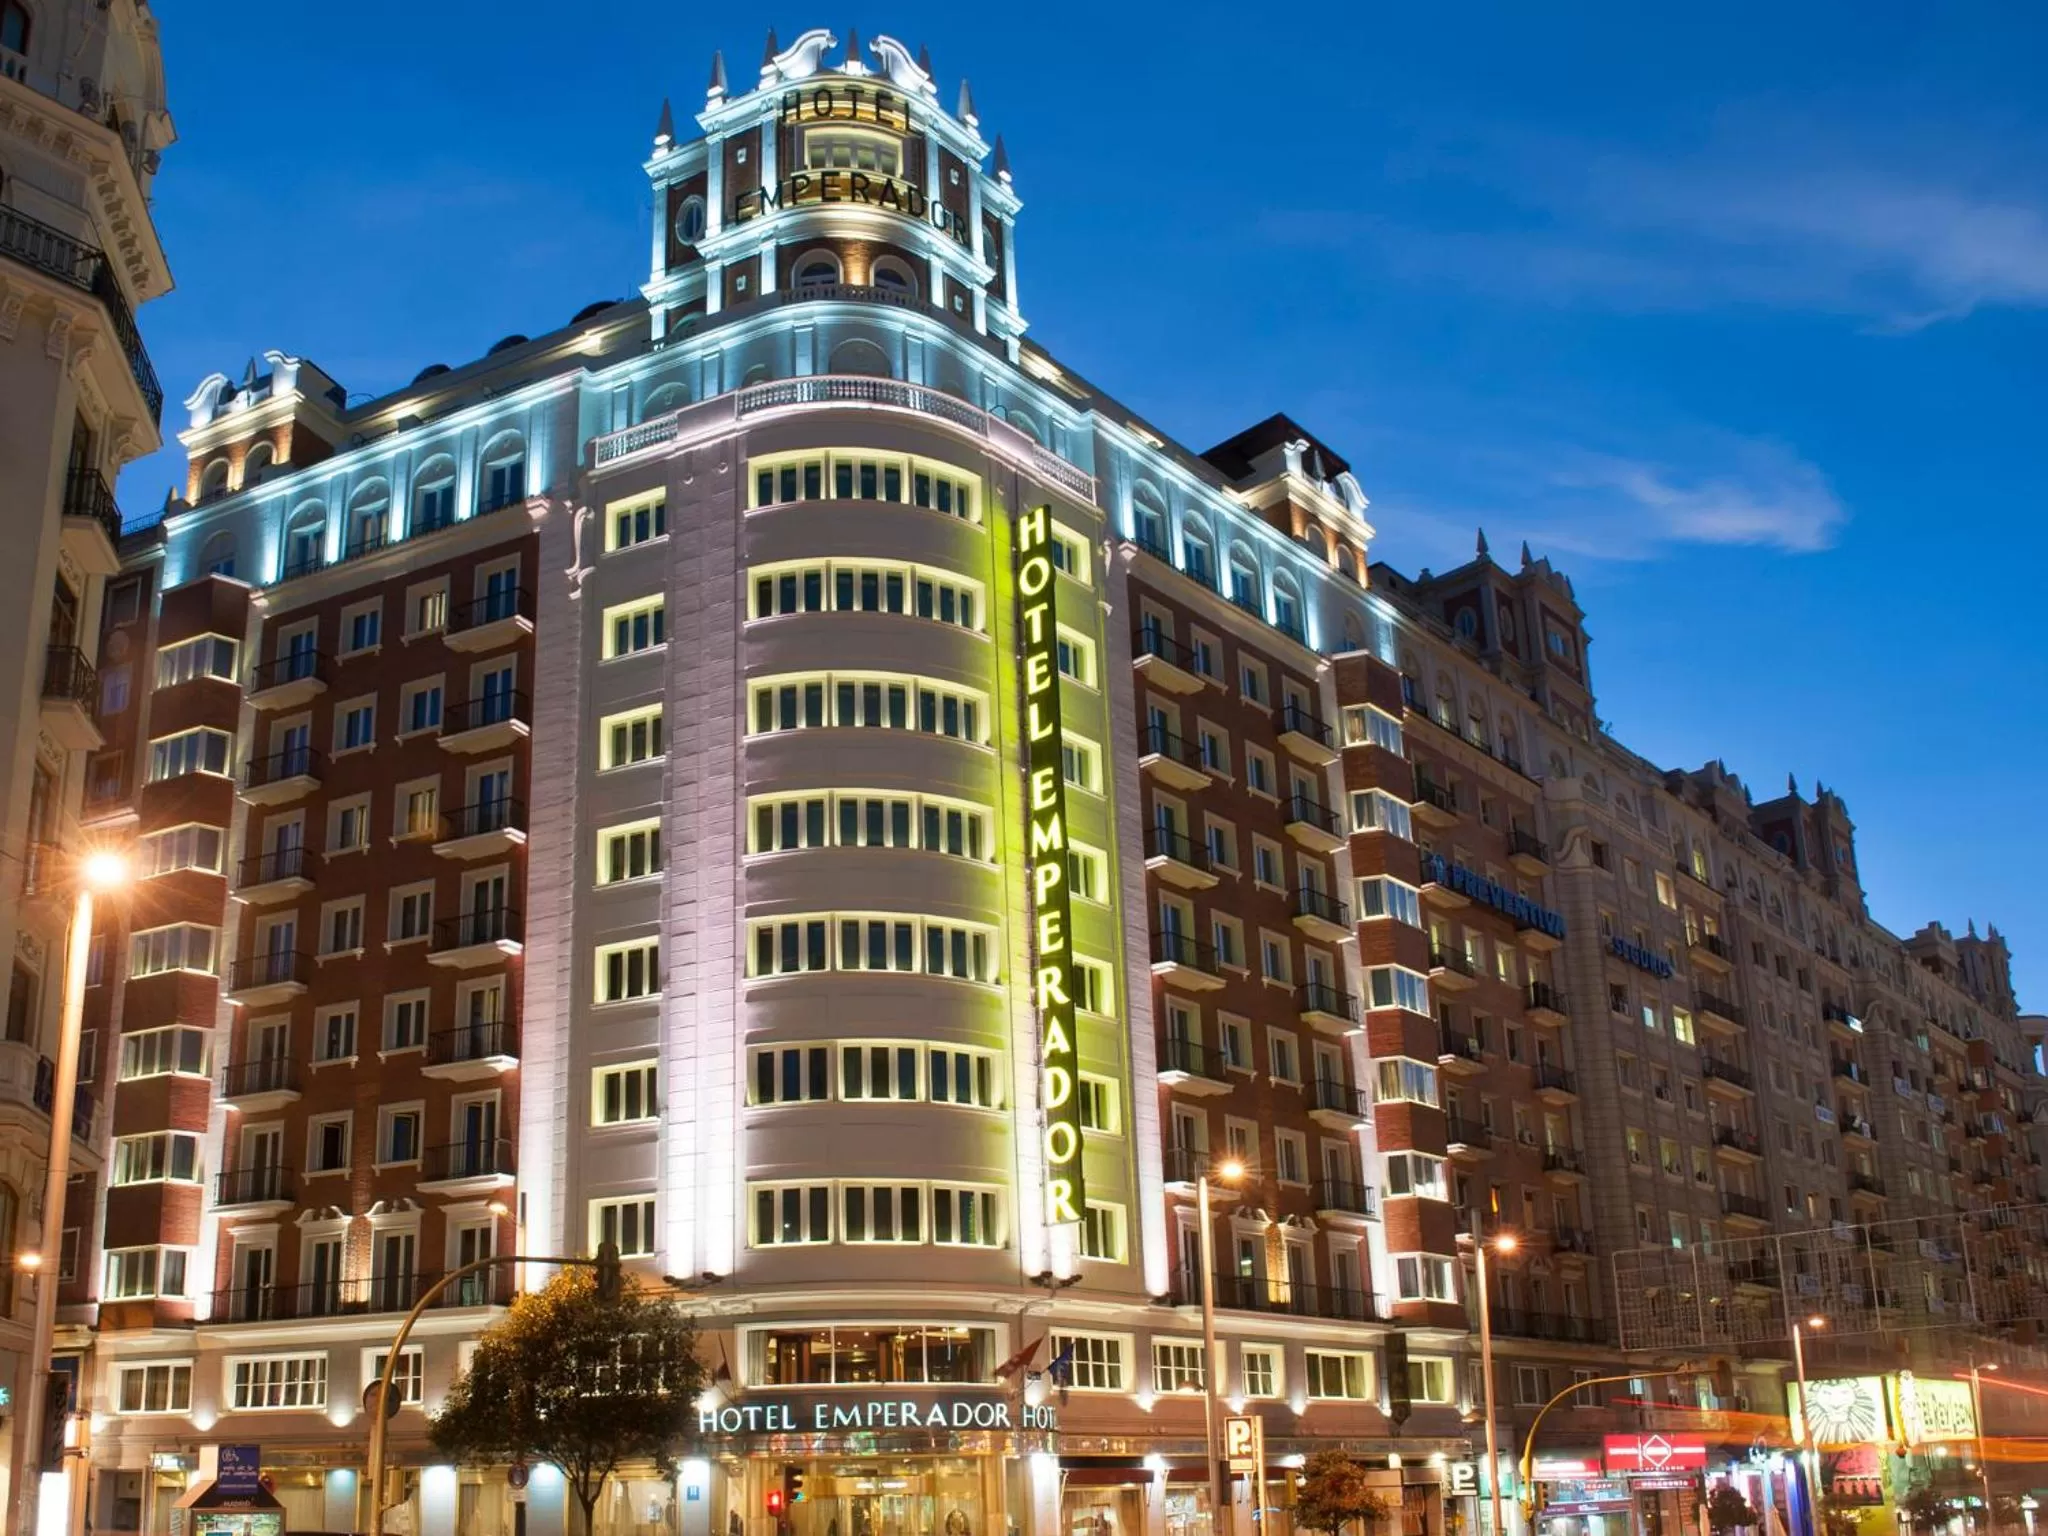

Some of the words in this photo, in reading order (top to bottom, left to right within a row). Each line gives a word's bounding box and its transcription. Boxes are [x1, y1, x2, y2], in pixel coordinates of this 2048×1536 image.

[781, 86, 915, 134] HOTEL
[735, 170, 968, 247] EMPERADOR
[1019, 507, 1053, 742] HOTEL
[1032, 767, 1080, 1222] EMPERADOR
[699, 1403, 797, 1433] HOTEL
[815, 1402, 1012, 1429] EMPERADOR
[1228, 1420, 1251, 1455] P
